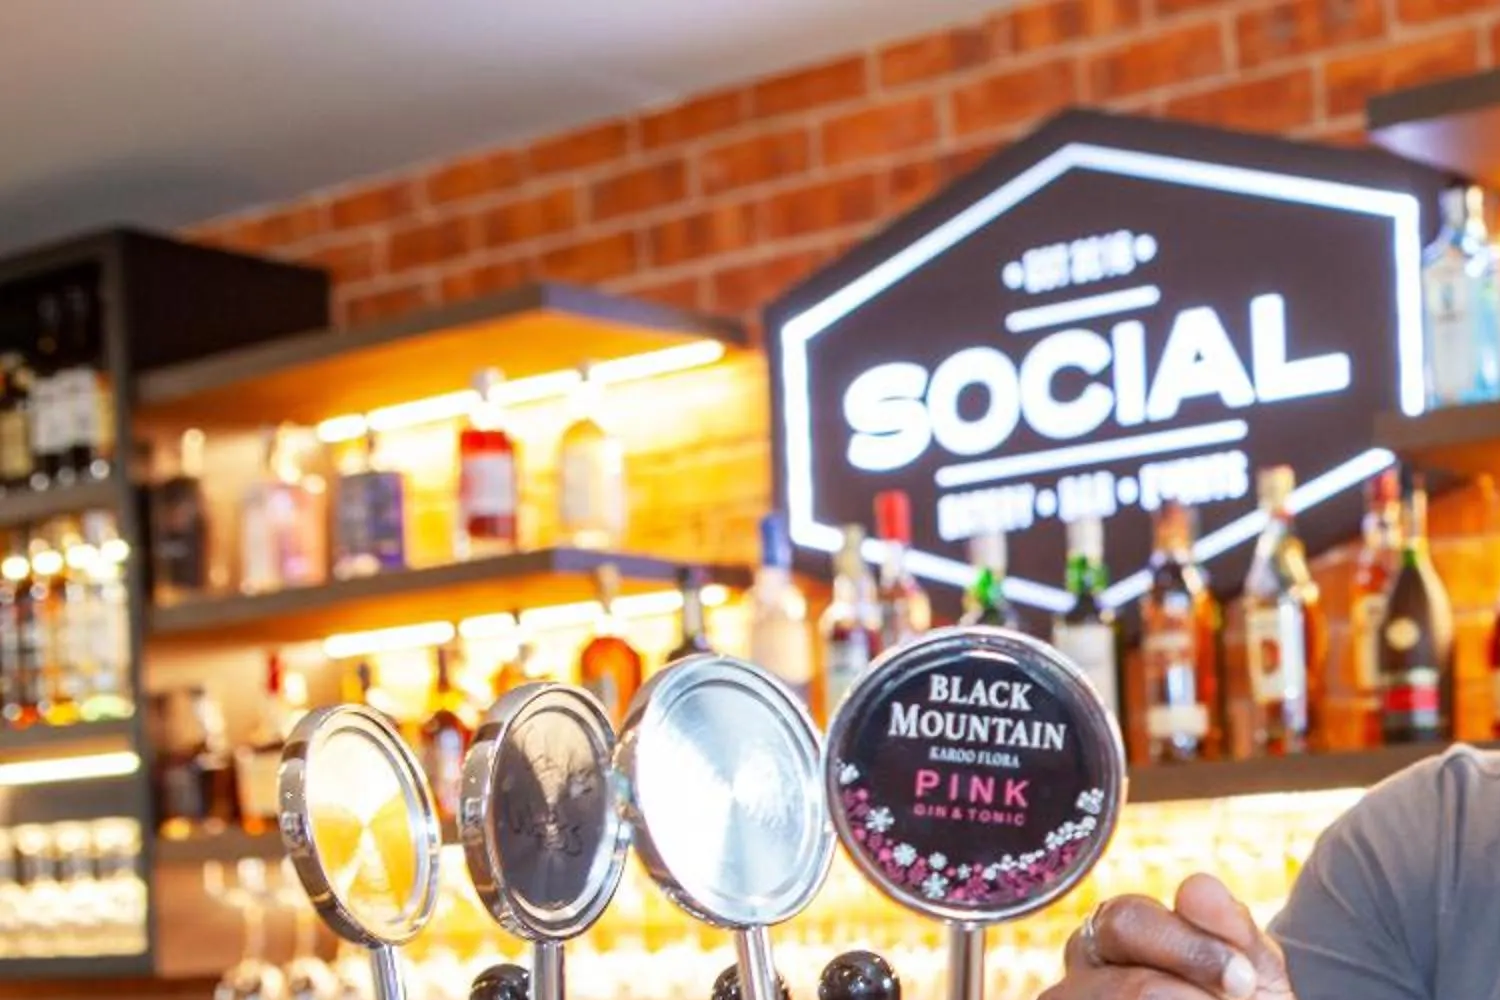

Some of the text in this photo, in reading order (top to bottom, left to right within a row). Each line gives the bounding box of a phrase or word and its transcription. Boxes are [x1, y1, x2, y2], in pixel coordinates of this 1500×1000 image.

[843, 292, 1352, 471] SOCIAL
[929, 674, 1033, 710] BLACK
[888, 702, 1066, 750] MOUNTAIN
[928, 746, 1021, 769] KAROO FLORA
[915, 770, 1029, 806] PINK
[912, 803, 1025, 826] GIN & TONIC
